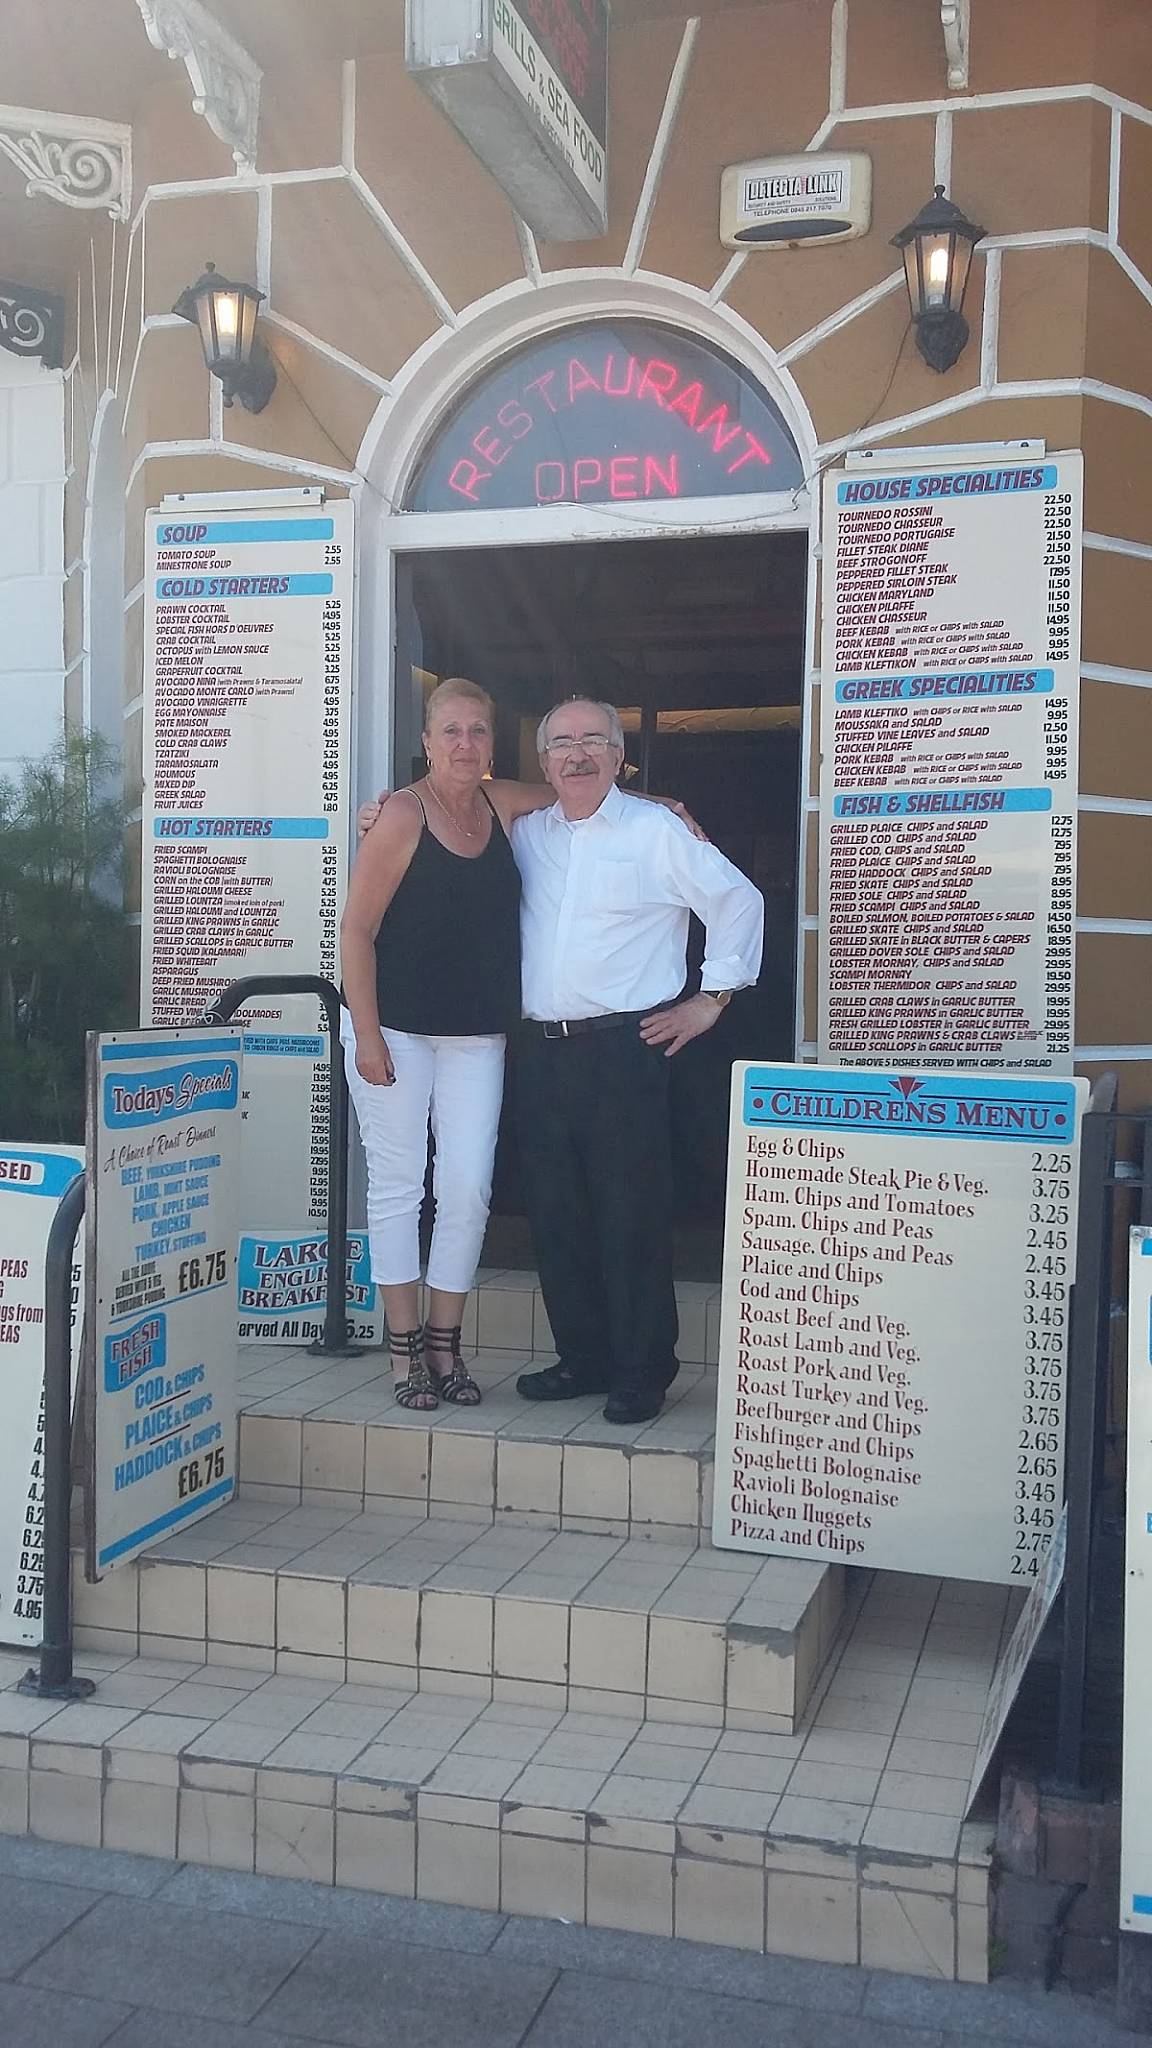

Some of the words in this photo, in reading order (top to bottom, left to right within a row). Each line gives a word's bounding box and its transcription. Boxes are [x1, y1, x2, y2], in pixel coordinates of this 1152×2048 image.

[493, 0, 536, 82] GRILLS
[539, 75, 544, 96] &
[548, 78, 569, 136] SEA
[573, 118, 602, 182] FOOD
[806, 174, 838, 194] LINK
[448, 354, 771, 502] RESTAURANT
[536, 455, 680, 502] OPEN
[845, 479, 912, 502] HOUSE
[916, 469, 1044, 497] SPECIALITIES
[838, 510, 891, 522] TOURNEDO
[893, 507, 933, 517] ROSSINI
[1044, 494, 1071, 504] 22.50
[163, 525, 207, 543] SOUP
[157, 552, 192, 560] TOMATO
[194, 550, 215, 558] SOUP
[836, 559, 858, 568] BEEF
[860, 554, 927, 566] STROGONOFF
[1047, 543, 1070, 552] 21.50
[162, 581, 204, 596] COLD
[208, 577, 289, 595] STARTERS
[836, 590, 877, 602] CHICKEN
[878, 589, 933, 600] MARYLAND
[1049, 579, 1070, 588] 11.50
[156, 667, 202, 675] GRAPEFRUIT
[204, 667, 243, 675] COCKTAIL
[842, 681, 904, 700] GREEK
[908, 672, 1037, 696] SPECIALITIES
[173, 708, 226, 716] MAYONNAISE
[835, 720, 889, 730] MOUSSAKA
[891, 720, 909, 728] and
[911, 718, 942, 727] SALAD
[1048, 711, 1067, 720] 9.95
[835, 744, 875, 753] CHICKEN
[877, 742, 912, 752] PILAFFE
[1046, 734, 1067, 744] 11.50
[155, 770, 195, 778] HOUMOUS
[154, 801, 175, 809] FRUIT
[177, 801, 203, 809] JUICES
[840, 797, 883, 815] FISH
[886, 797, 901, 812] &
[905, 792, 1005, 812] SHELLFISH
[160, 821, 192, 835] HOT
[195, 820, 272, 835] STARTERS
[154, 846, 175, 854] FRIED
[829, 970, 866, 979] SCAMPI
[867, 970, 912, 979] MORNAY
[1047, 971, 1071, 980] 19.50
[114, 1083, 174, 1114] Todays
[176, 1065, 232, 1107] Specials
[771, 1092, 946, 1124] CHILDRENS
[956, 1102, 1050, 1129] MENU
[104, 1149, 115, 1172] A
[119, 1145, 144, 1167] Choice
[147, 1137, 155, 1162] of
[158, 1132, 184, 1155] Roast
[186, 1126, 216, 1147] Dinners
[746, 1135, 776, 1158] Egg
[783, 1138, 793, 1155] &
[797, 1138, 845, 1160] Chips
[1031, 1153, 1071, 1173] 2.25
[185, 1175, 208, 1191] SAUCE
[745, 1160, 843, 1183] Homemade
[849, 1167, 901, 1190] Steak
[904, 1170, 932, 1189] Pie
[938, 1175, 950, 1190] &
[953, 1173, 989, 1196] Veg.
[1032, 1179, 1071, 1198] 3.75
[186, 1193, 209, 1210] SAUCE
[795, 1187, 842, 1210] Chips
[847, 1193, 878, 1210] and
[885, 1194, 975, 1217] Tomatoes
[1029, 1204, 1069, 1224] 3.25
[152, 1213, 191, 1238] CHICKEN
[178, 1250, 226, 1293] £6.75
[820, 1237, 868, 1261] Chips
[873, 1245, 906, 1262] and
[912, 1246, 954, 1266] Peas
[1025, 1255, 1066, 1275] 2.45
[16, 1304, 43, 1323] from
[740, 1279, 769, 1299] Cod
[775, 1284, 806, 1302] and
[811, 1283, 859, 1307] Chips
[1023, 1306, 1064, 1327] 3.45
[112, 1320, 160, 1361] FRESH
[282, 1322, 298, 1336] All
[739, 1302, 790, 1324] Roast
[795, 1307, 834, 1328] Beef
[838, 1314, 871, 1332] and
[877, 1316, 910, 1338] Veg.
[1025, 1331, 1063, 1352] 3.75
[120, 1346, 151, 1382] FISH
[134, 1376, 164, 1409] COD
[166, 1381, 174, 1396] &
[175, 1364, 204, 1392] CHIPS
[737, 1374, 786, 1396] Roast
[792, 1380, 851, 1406] Turkey
[856, 1390, 889, 1408] and
[894, 1391, 929, 1413] Veg.
[1022, 1406, 1059, 1427] 3.75
[125, 1408, 173, 1449] PLAICE
[174, 1411, 181, 1426] &
[182, 1393, 213, 1421] CHIPS
[114, 1435, 183, 1491] HADDOCK
[184, 1440, 191, 1454] &
[193, 1422, 221, 1451] CHIPS
[178, 1447, 225, 1499] £6.75
[732, 1447, 817, 1474] Spaghetti
[823, 1456, 921, 1486] Bolognaise
[1015, 1481, 1055, 1502] 3.45
[731, 1494, 797, 1520] Chicken
[802, 1504, 871, 1529] Nuggets
[1015, 1531, 1052, 1552] 2.75
[731, 1518, 775, 1541] Pizza
[780, 1528, 812, 1546] and
[817, 1530, 865, 1554] Chips
[1010, 1555, 1040, 1577] 2.4
